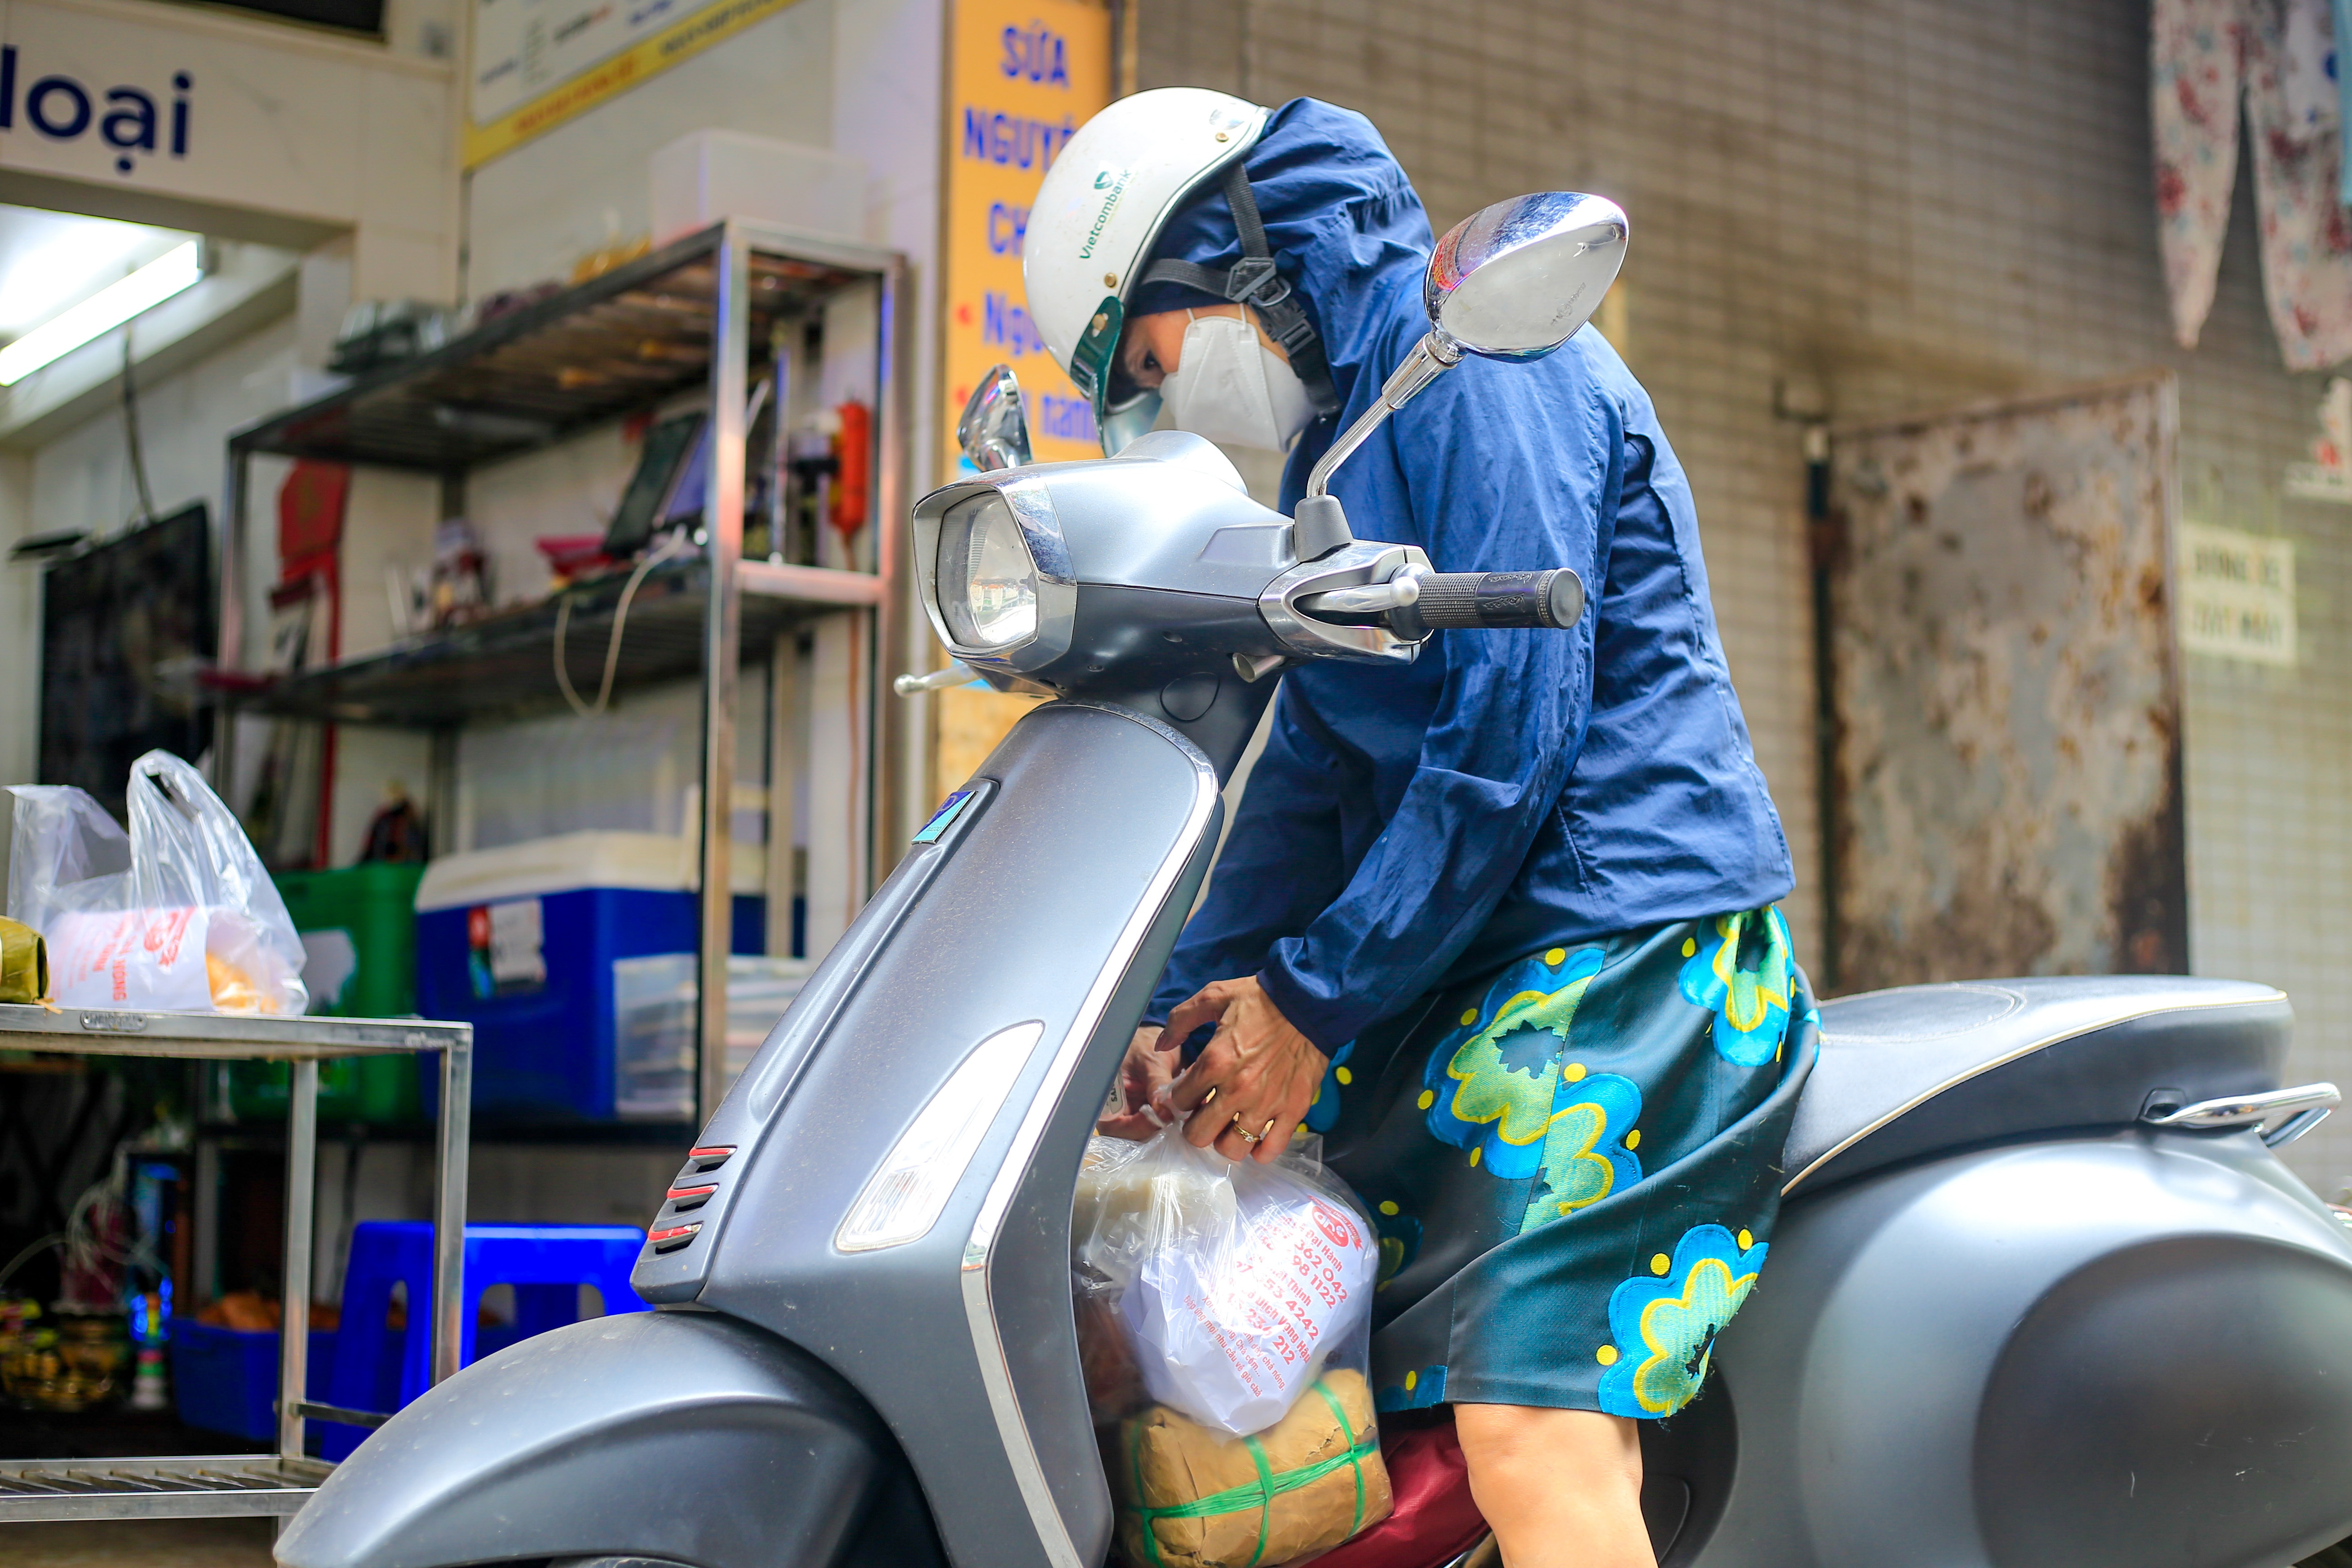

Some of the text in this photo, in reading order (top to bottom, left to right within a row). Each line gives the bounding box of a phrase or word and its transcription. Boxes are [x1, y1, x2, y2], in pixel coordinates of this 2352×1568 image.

[0, 46, 190, 174] loại
[990, 202, 1030, 257] CH
[1079, 168, 1132, 260] Vietcombank
[1306, 1230, 1343, 1272] Đại Hành
[1288, 1278, 1312, 1307] Thịnh
[1292, 1255, 1310, 1276] 98
[1310, 1274, 1337, 1309] 1122
[1316, 1267, 1348, 1303] 042
[1277, 1316, 1299, 1343] Vọng
[1297, 1340, 1311, 1364] Hậu
[1285, 1301, 1319, 1340] 4242
[1193, 1308, 1207, 1321] ứng
[1204, 1320, 1218, 1335] mọi
[1215, 1333, 1228, 1348] nhu
[1225, 1348, 1237, 1362] cầu
[1235, 1362, 1245, 1372] về
[1240, 1371, 1253, 1383] giò
[1250, 1383, 1262, 1397] chả
[1236, 1339, 1247, 1355] Chả
[1272, 1335, 1295, 1365] 212
[1262, 1356, 1275, 1371] chả
[1271, 1369, 1286, 1391] nóng,
